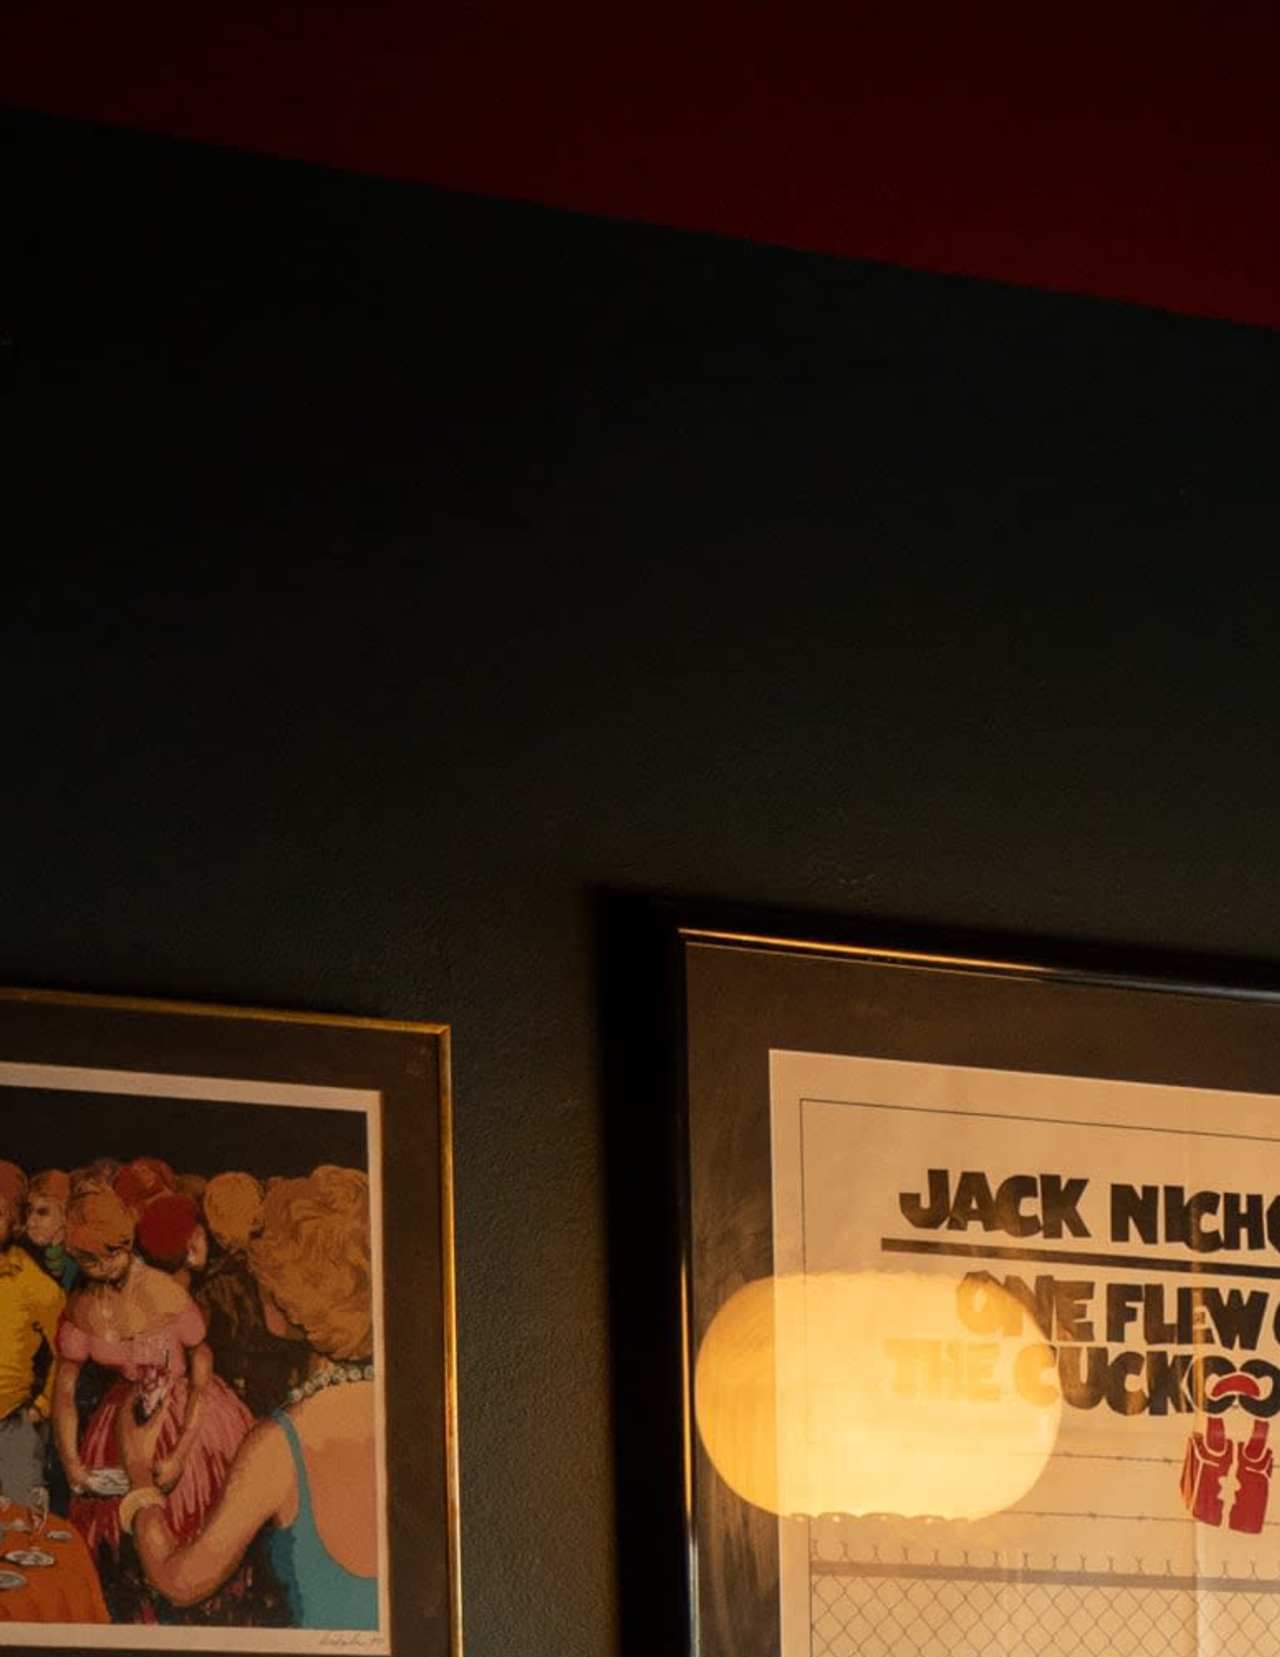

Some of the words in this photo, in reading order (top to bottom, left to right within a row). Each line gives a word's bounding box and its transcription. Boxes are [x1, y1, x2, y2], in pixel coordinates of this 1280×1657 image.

[900, 1168, 1091, 1238] JACK
[956, 1271, 1095, 1343] ONE
[1106, 1283, 1269, 1350] FLEW
